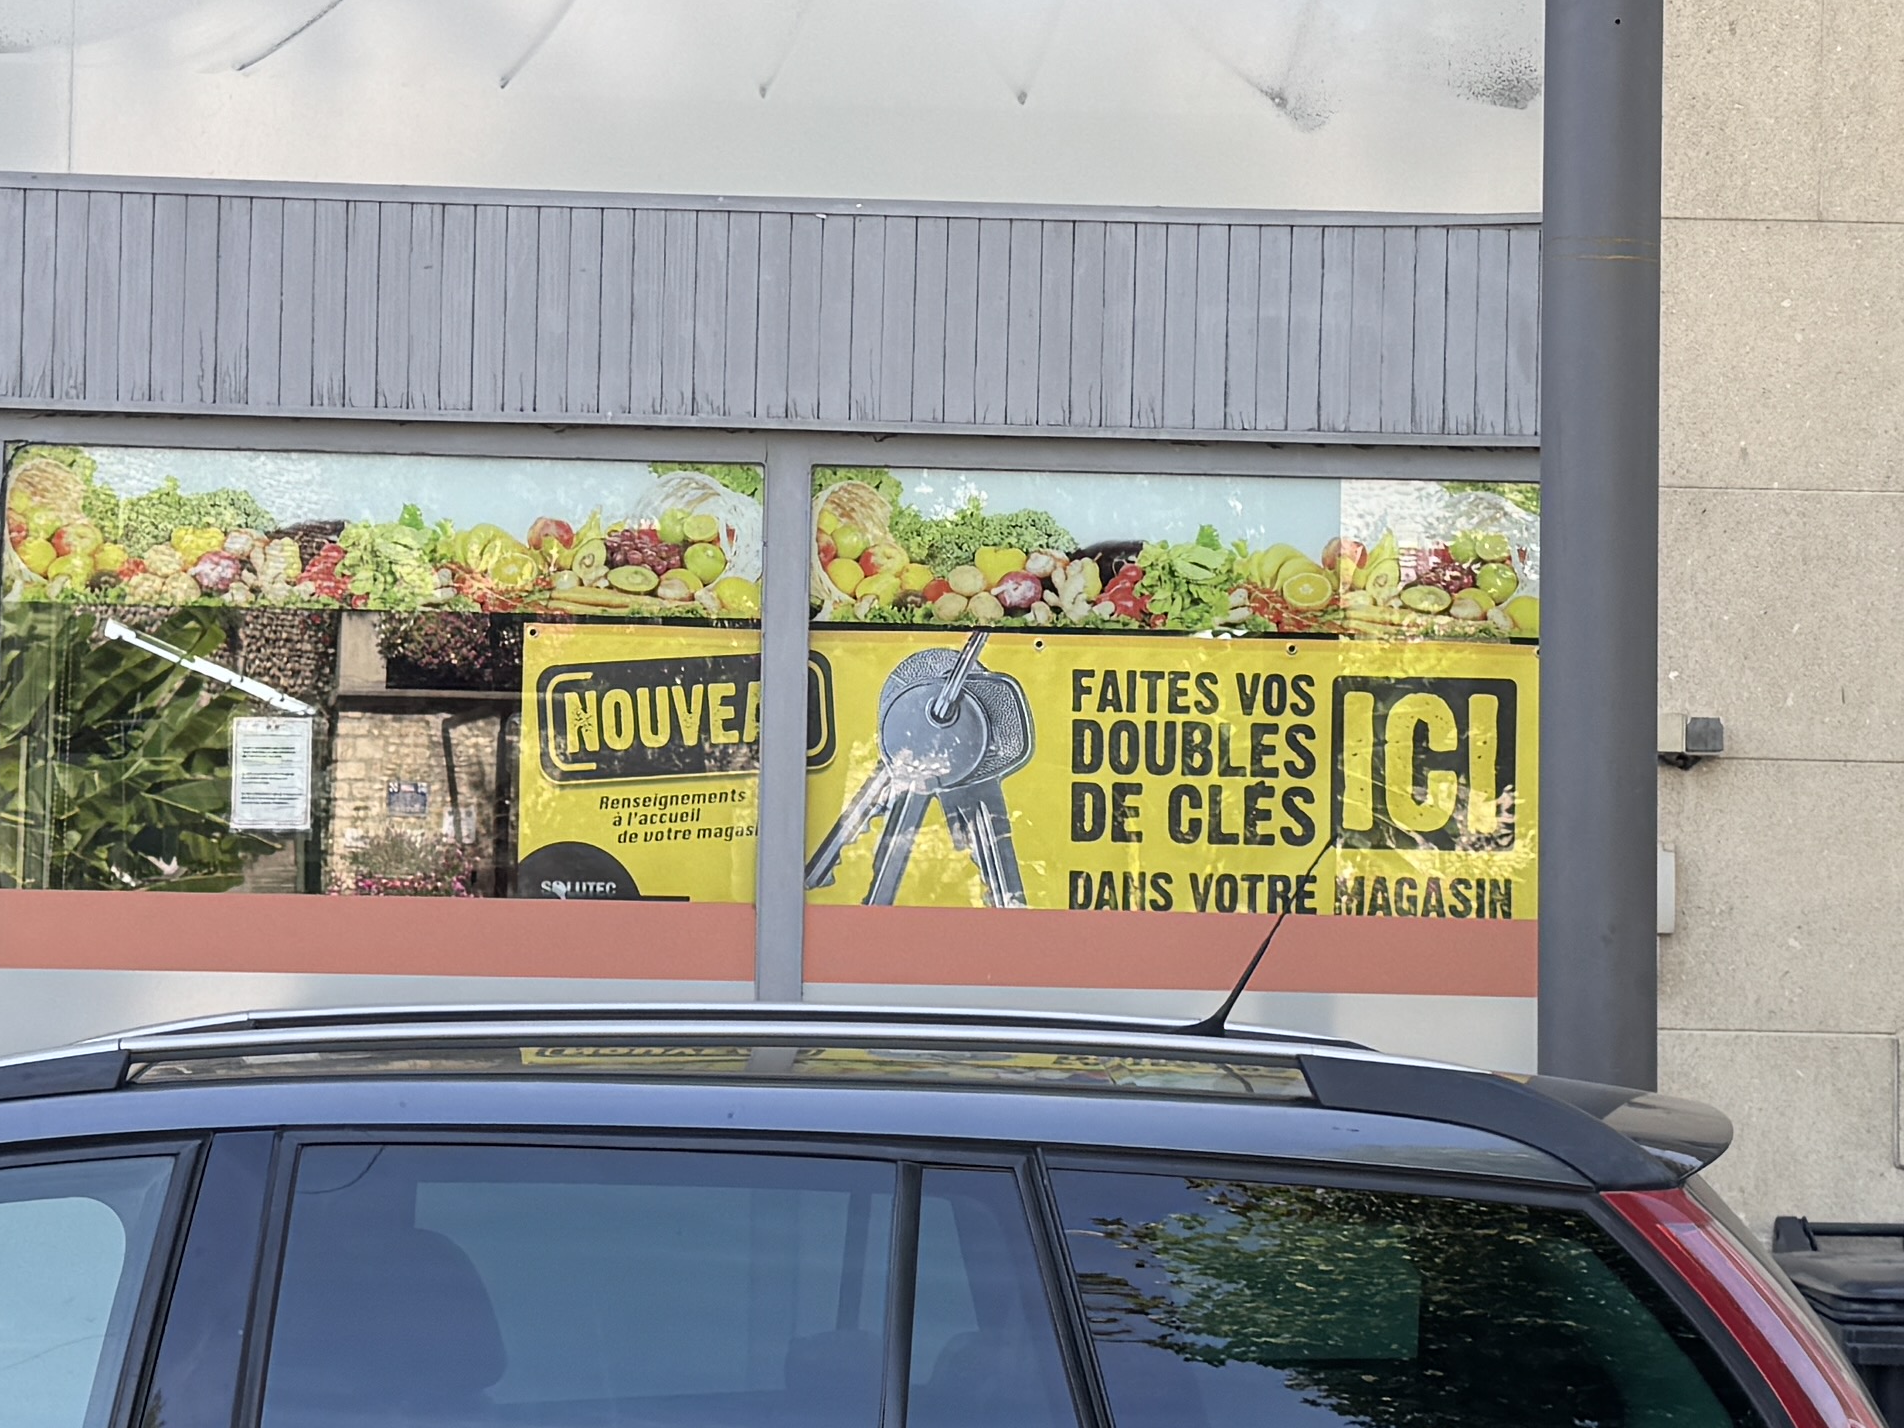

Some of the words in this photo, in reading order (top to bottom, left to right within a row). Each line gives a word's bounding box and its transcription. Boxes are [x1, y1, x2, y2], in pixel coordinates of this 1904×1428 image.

[1071, 668, 1219, 715] FAITES
[1236, 672, 1316, 717] VOS
[1071, 720, 1316, 780] DOUBLES
[1340, 691, 1500, 835] ICI
[599, 788, 747, 811] Renseignements
[612, 812, 622, 827] à
[627, 808, 701, 826] l'accueil
[1070, 780, 1144, 844] DE
[617, 829, 638, 844] de
[643, 827, 692, 843] votre
[696, 824, 759, 843] magasi
[1069, 870, 1174, 912] DANS
[1191, 872, 1318, 914] VOTRE
[1334, 875, 1513, 920] MAGASIN
